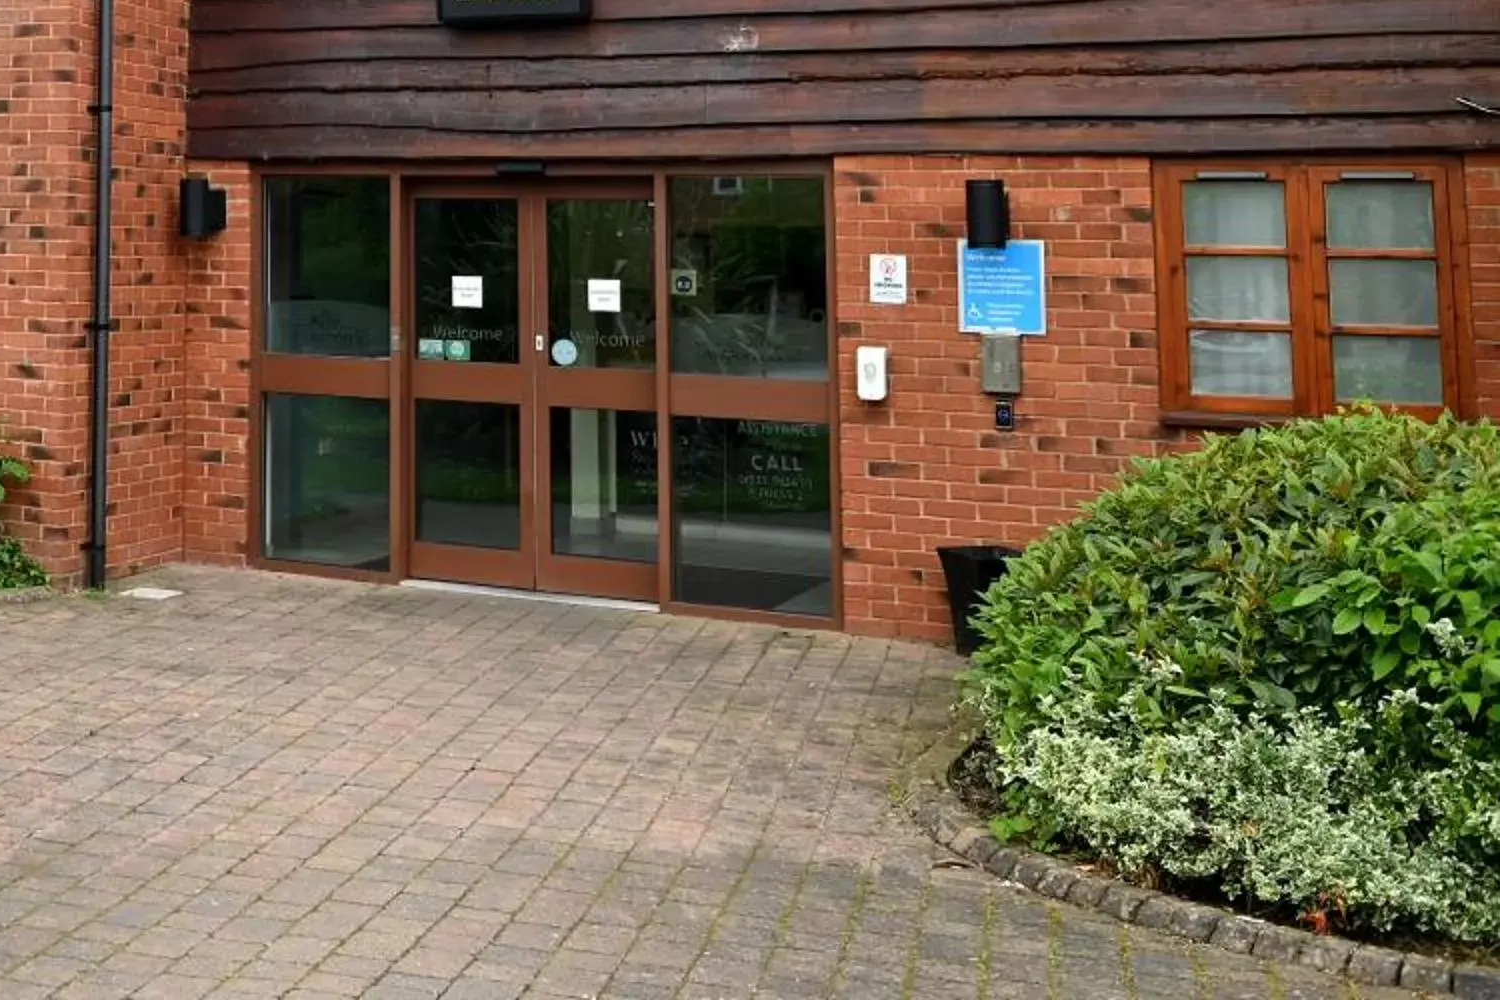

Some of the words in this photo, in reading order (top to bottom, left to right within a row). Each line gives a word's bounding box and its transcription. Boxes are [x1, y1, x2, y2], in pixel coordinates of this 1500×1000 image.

[433, 325, 503, 341] Welcome
[570, 330, 645, 347] Welcome
[751, 454, 803, 471] CALL
